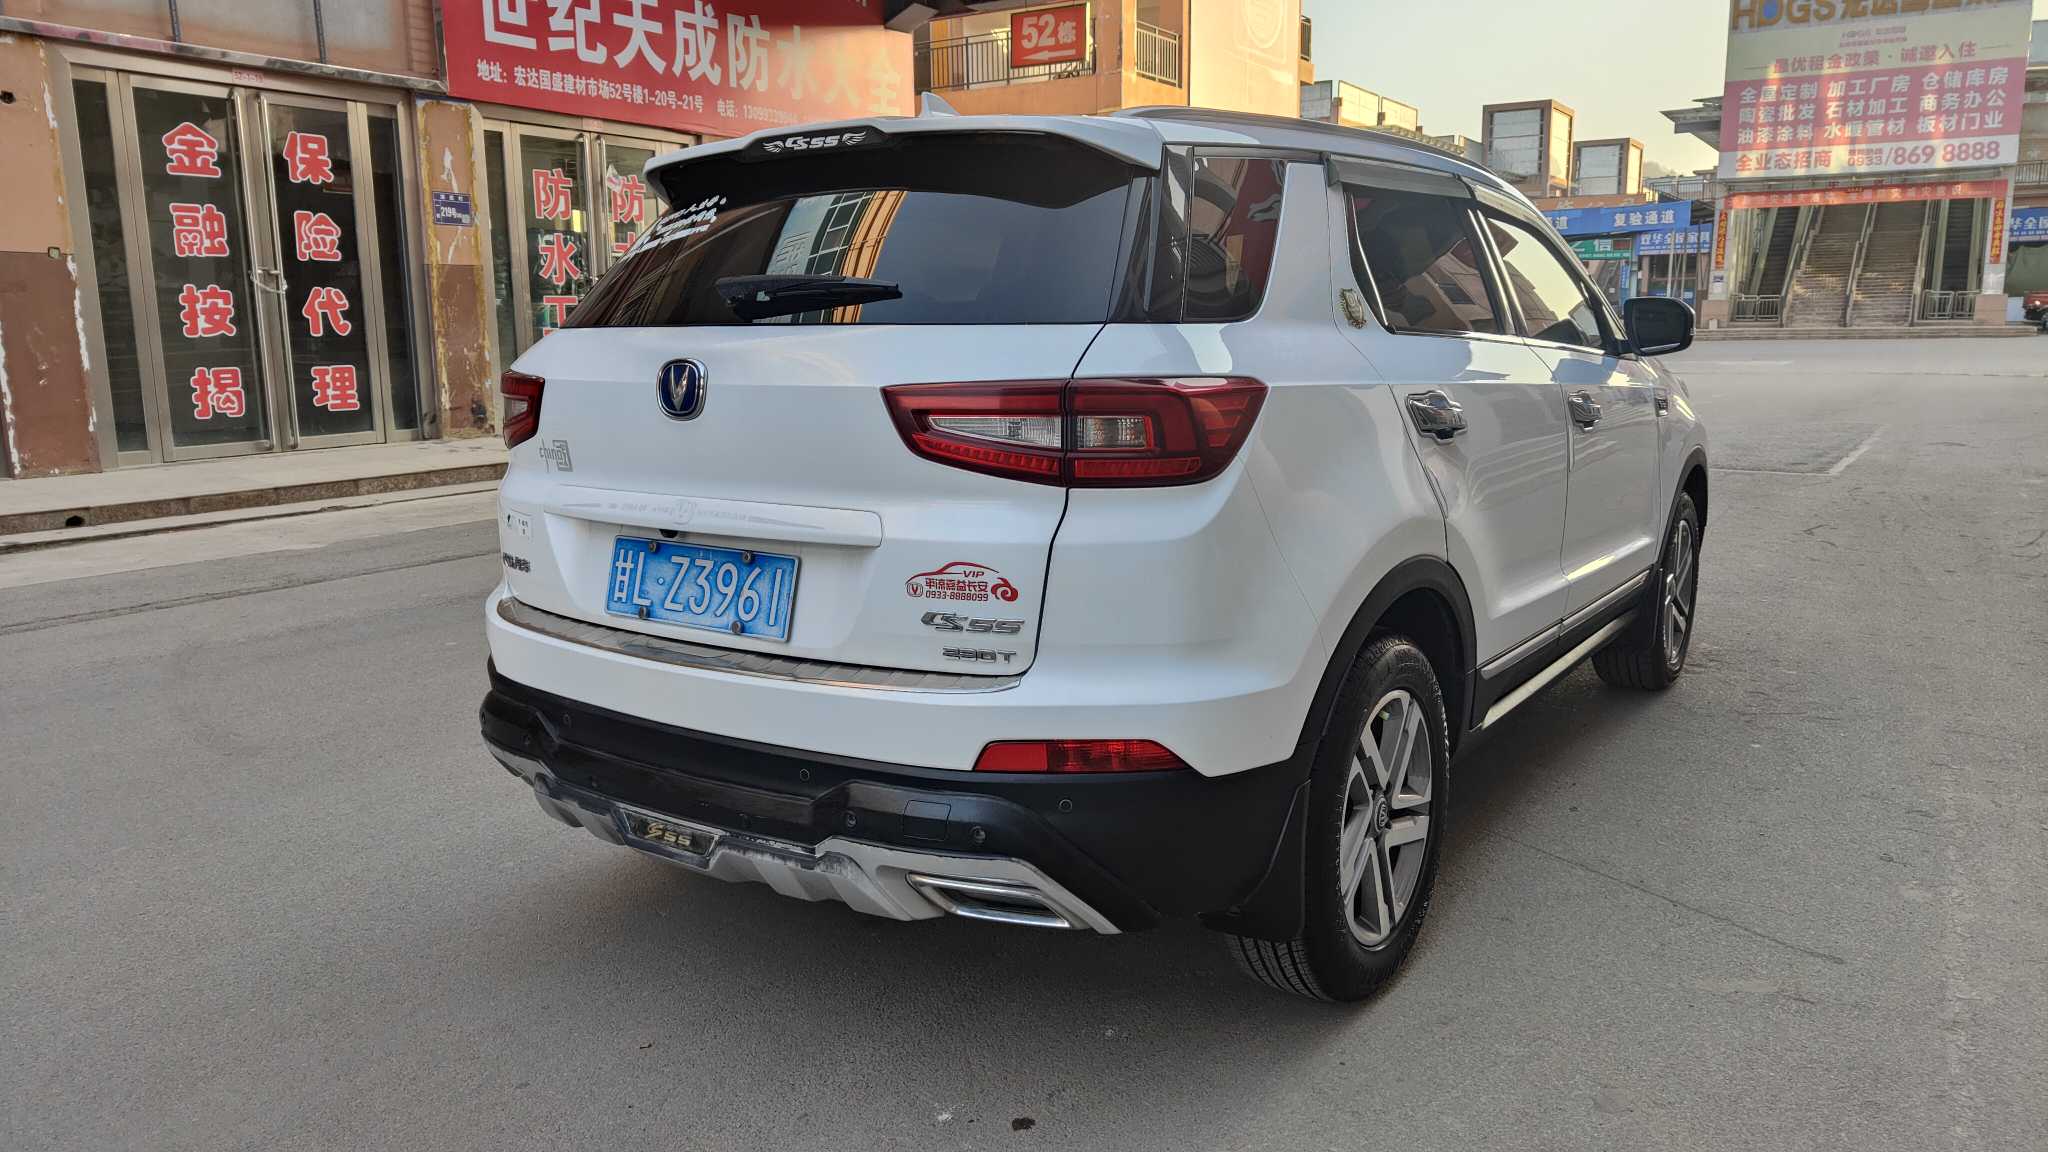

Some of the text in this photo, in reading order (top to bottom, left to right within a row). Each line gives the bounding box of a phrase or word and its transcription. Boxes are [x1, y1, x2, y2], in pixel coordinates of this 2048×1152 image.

[482, 0, 903, 116] 世纪天成防水大全
[1739, 66, 2009, 104] 全屋定制 加工厂房 仓储库房
[1738, 89, 2006, 124] 陶瓷批发 石材加工 商务办公
[1737, 110, 2004, 145] 油漆涂料 水暖管材 板材门业
[1736, 150, 1832, 172] 全业态招商
[162, 121, 246, 420] 金融按揭
[283, 131, 360, 411] 保险代理
[962, 570, 985, 578] VIP
[921, 610, 1025, 634] CS55
